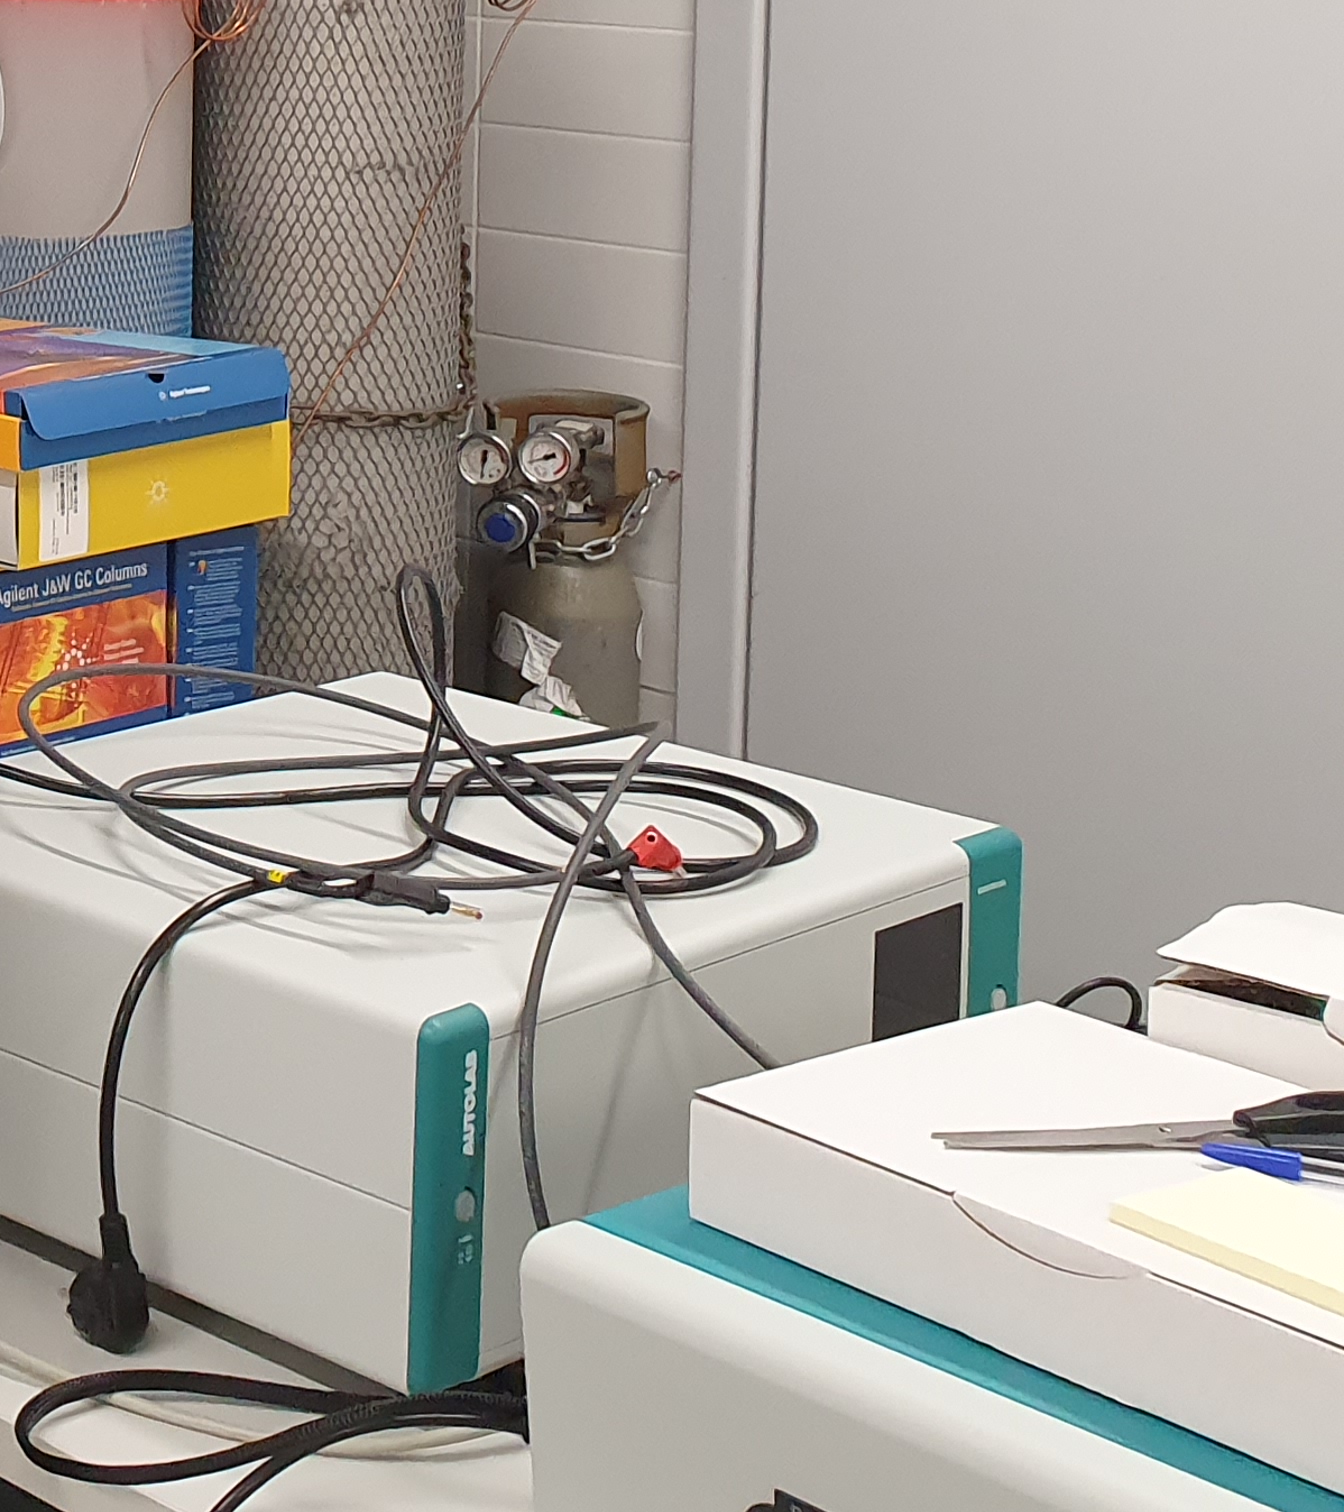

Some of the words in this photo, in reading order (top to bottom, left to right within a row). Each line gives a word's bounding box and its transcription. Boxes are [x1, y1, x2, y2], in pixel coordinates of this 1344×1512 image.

[41, 574, 72, 597] J&W
[74, 570, 93, 589] GC
[95, 562, 148, 585] Columns
[463, 1049, 478, 1157] AUTOLAB
